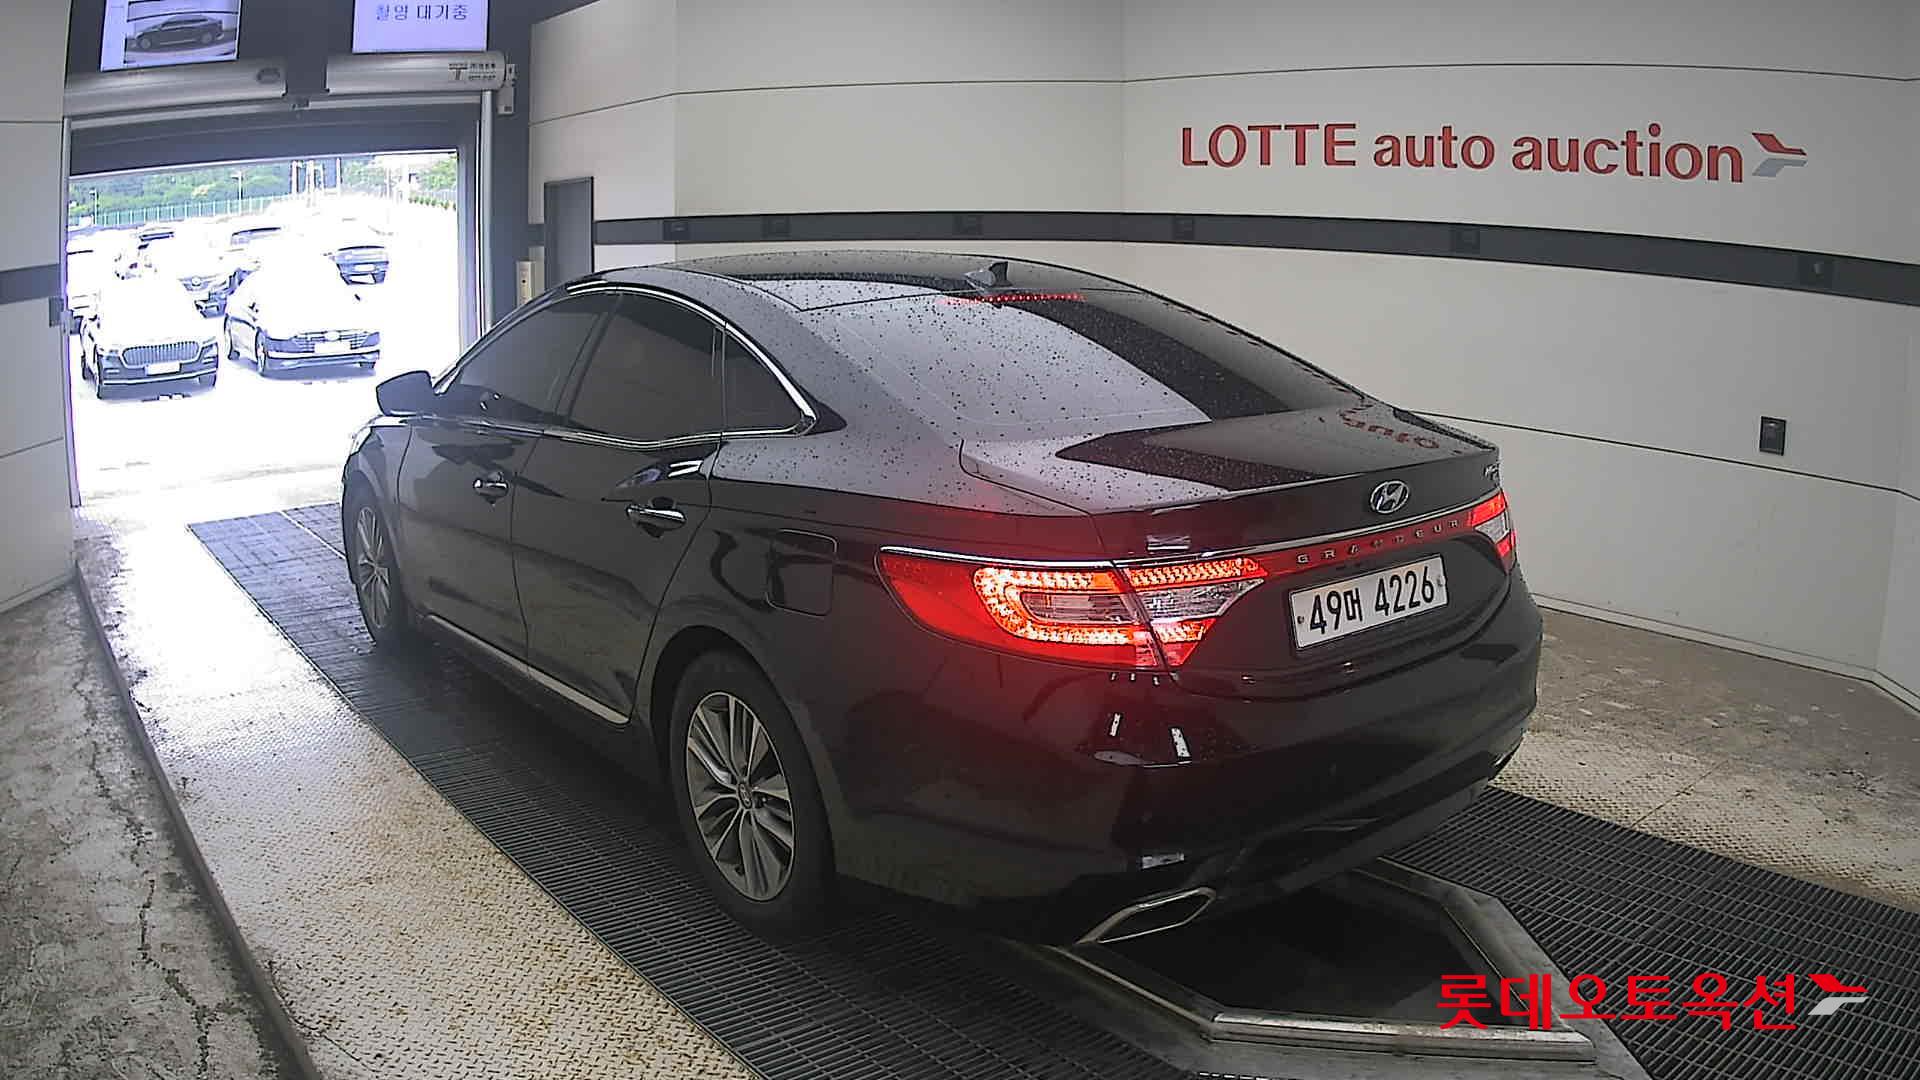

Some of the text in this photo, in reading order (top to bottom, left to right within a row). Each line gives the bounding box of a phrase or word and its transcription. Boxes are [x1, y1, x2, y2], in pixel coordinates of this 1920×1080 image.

[417, 5, 467, 20] 대기중
[1182, 123, 1743, 183] LOTTE auto auction
[1297, 519, 1459, 563] GRANDEUR
[1310, 566, 1435, 634] 49머 4226
